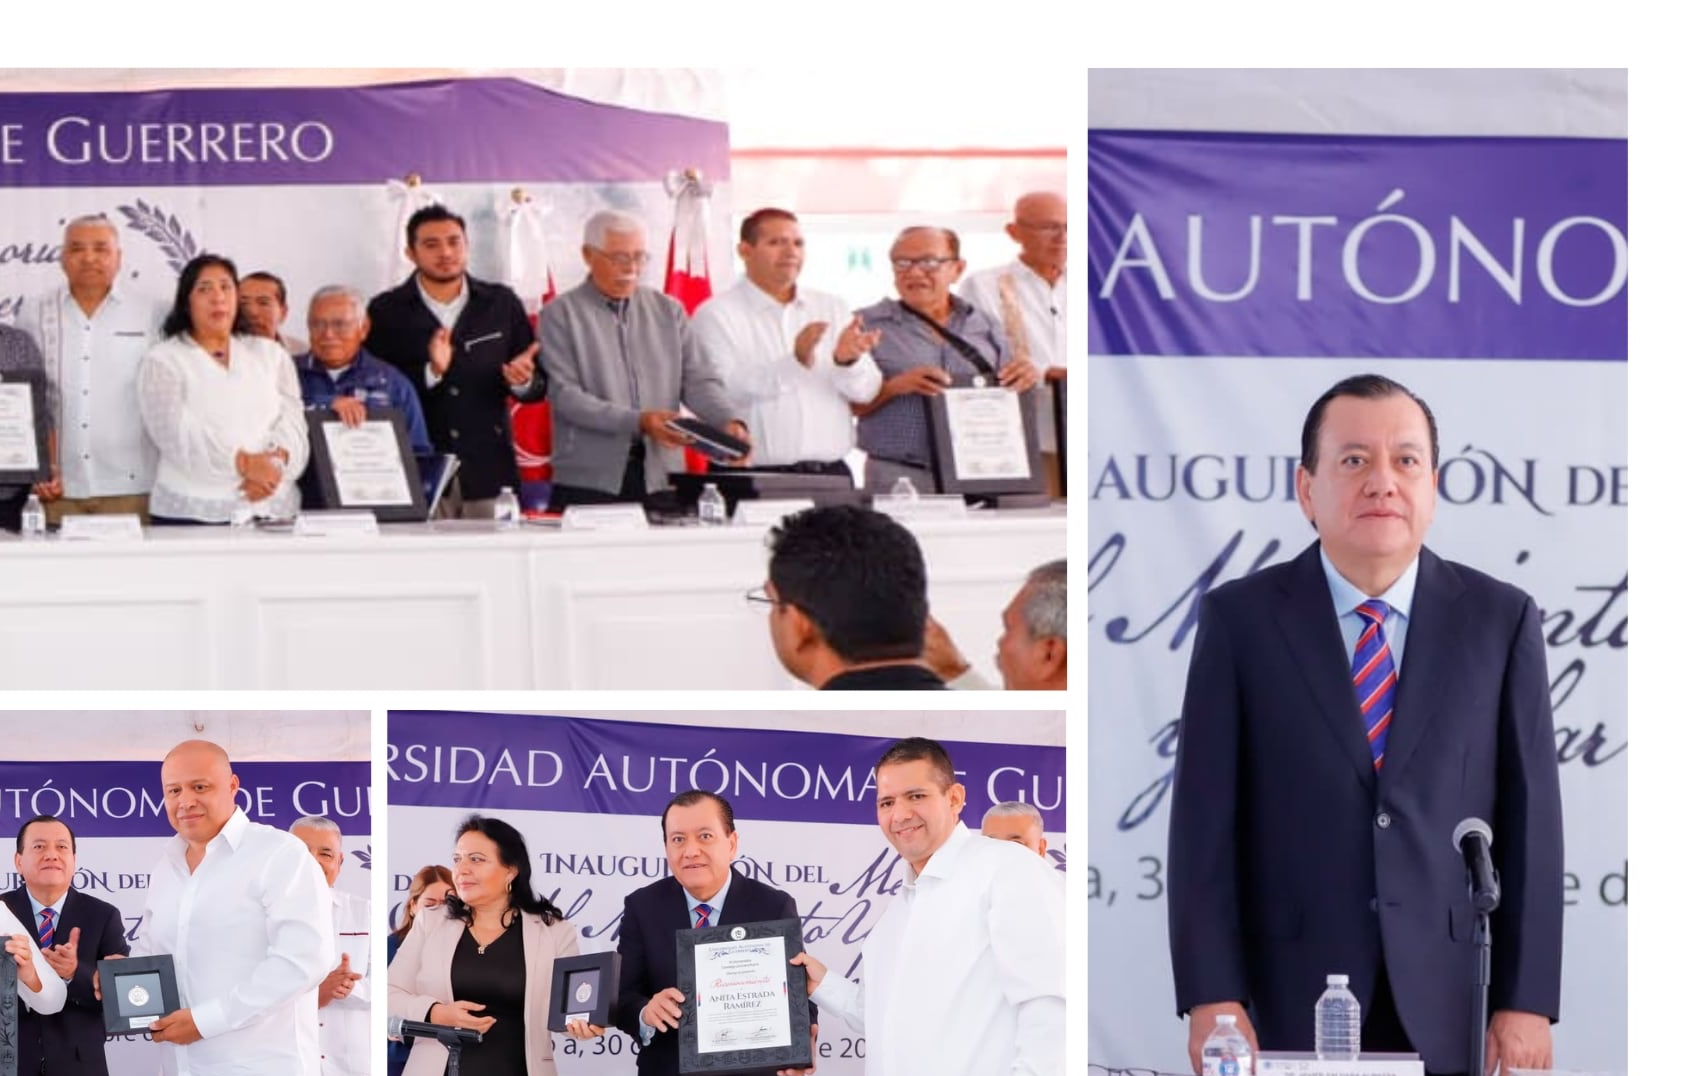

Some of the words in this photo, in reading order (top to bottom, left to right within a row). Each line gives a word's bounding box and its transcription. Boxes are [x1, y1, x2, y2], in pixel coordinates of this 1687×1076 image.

[46, 115, 335, 164] GUERRERO
[1098, 187, 1628, 307] AUTÓNO
[292, 780, 371, 818] GU
[785, 864, 830, 884] DEL
[710, 995, 735, 1003] ANITA
[737, 991, 775, 1000] ESTRADA
[723, 1000, 761, 1010] RAMÍREZ
[592, 1034, 624, 1055] 30
